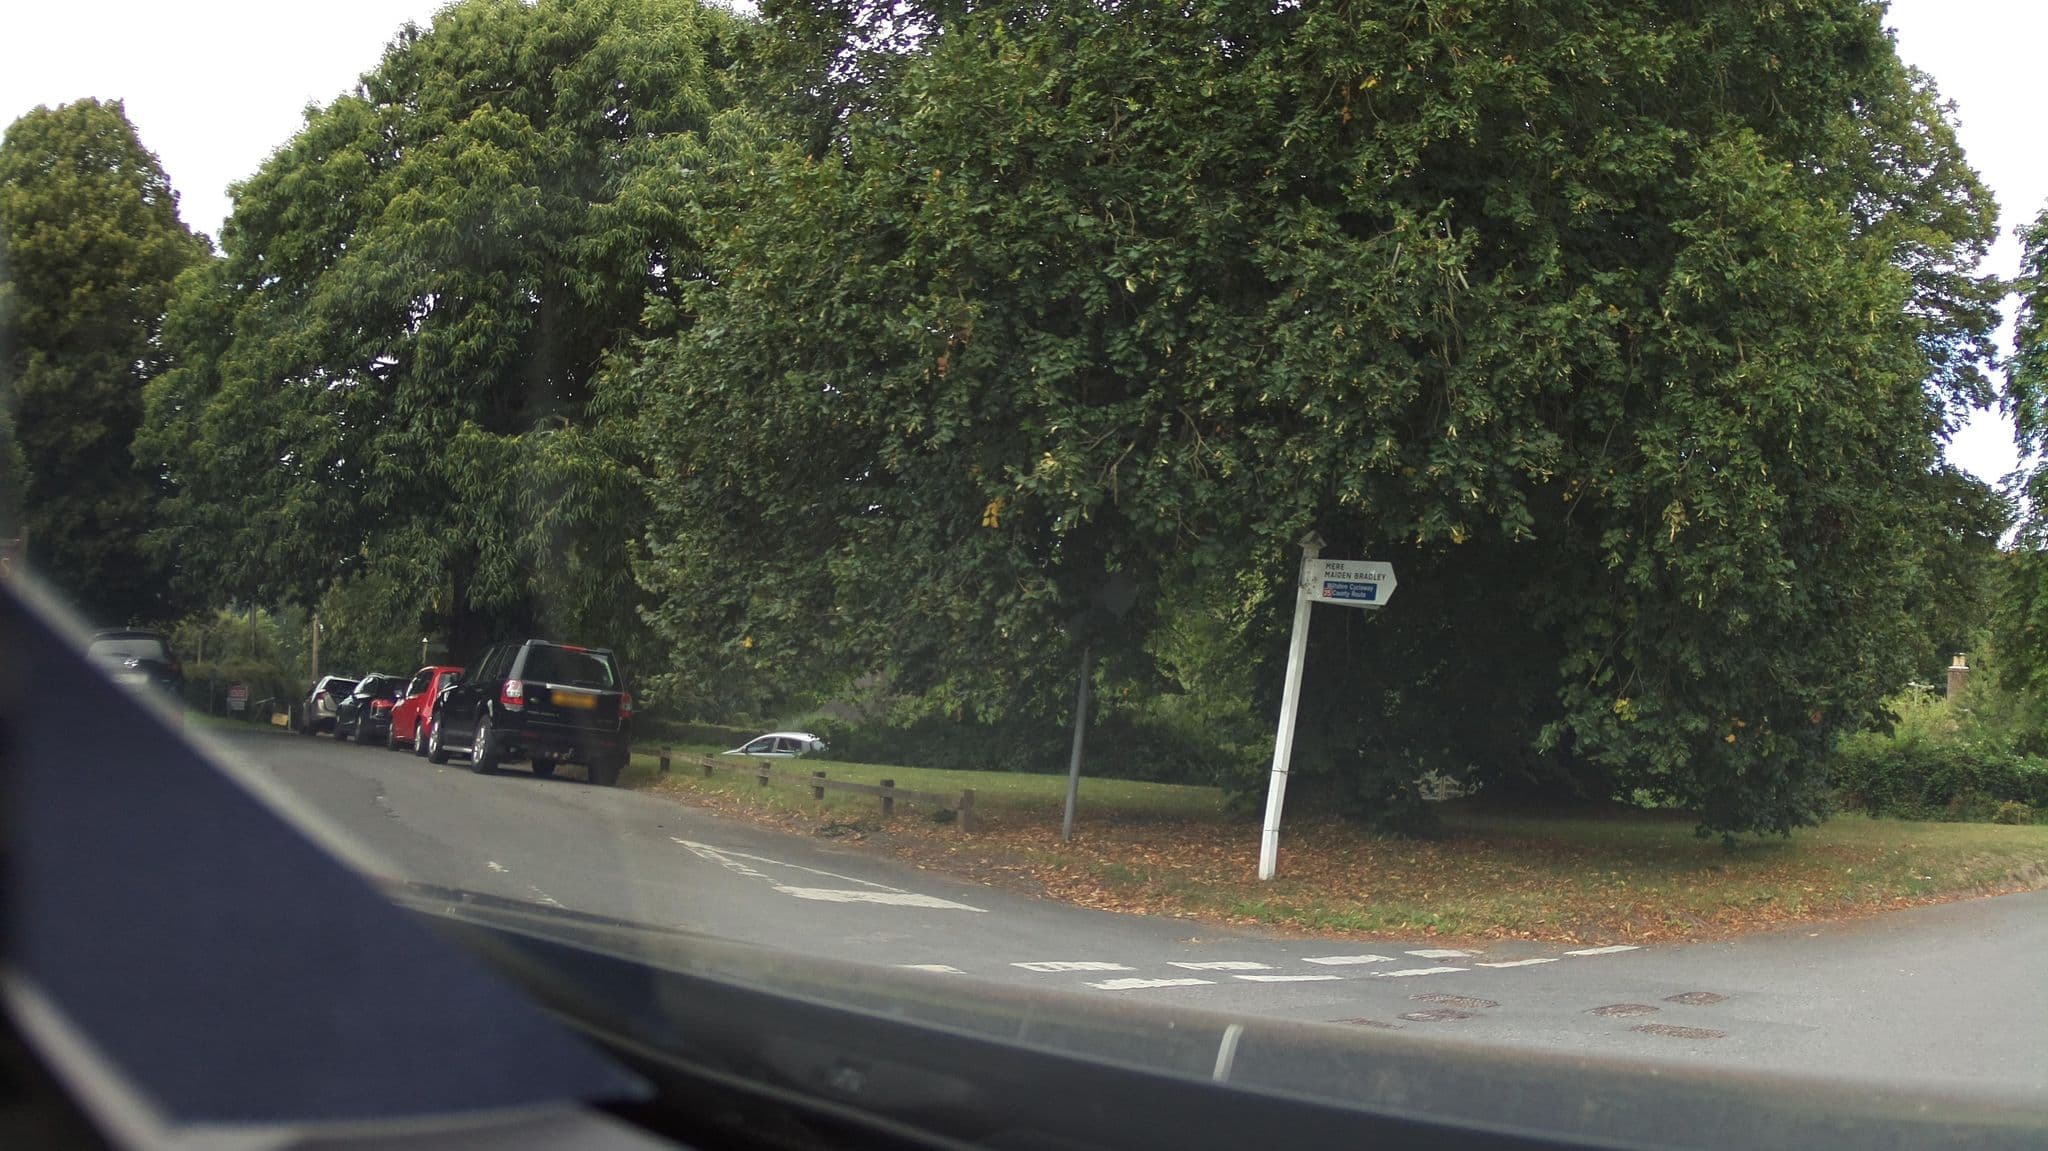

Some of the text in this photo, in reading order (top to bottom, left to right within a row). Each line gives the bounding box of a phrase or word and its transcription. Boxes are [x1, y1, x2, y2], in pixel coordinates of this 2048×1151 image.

[1325, 563, 1345, 571] MERE
[1324, 571, 1386, 581] MAIDEN BRADLEY
